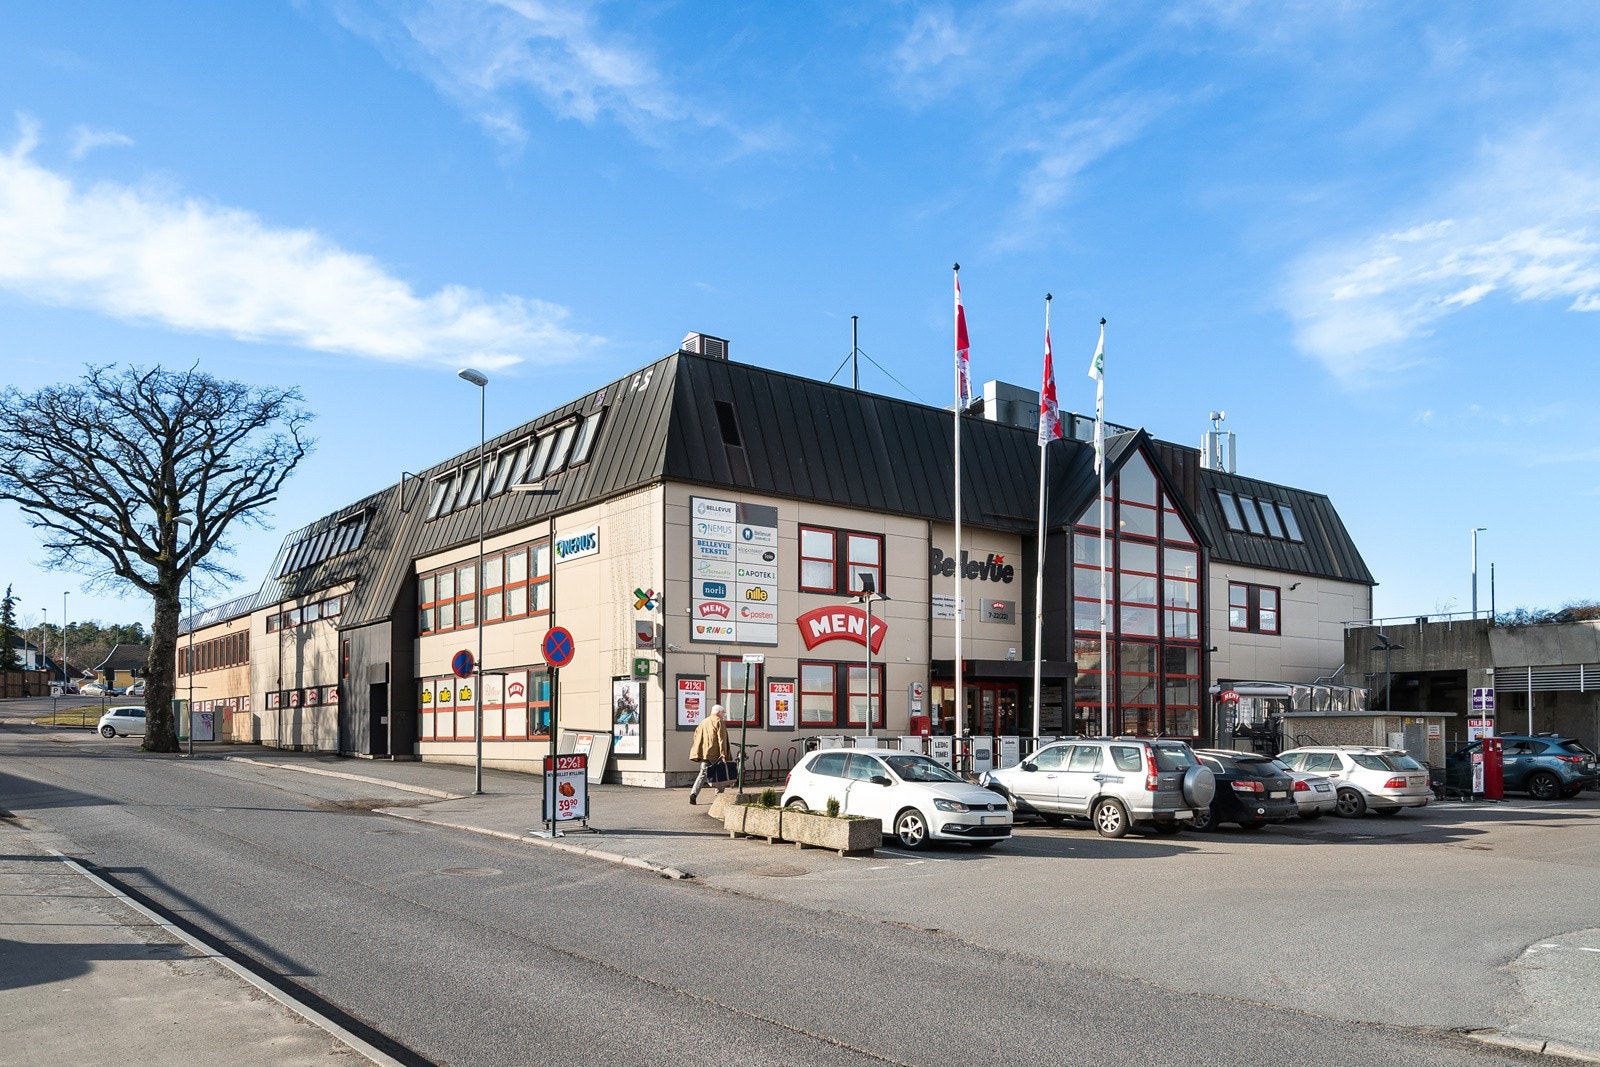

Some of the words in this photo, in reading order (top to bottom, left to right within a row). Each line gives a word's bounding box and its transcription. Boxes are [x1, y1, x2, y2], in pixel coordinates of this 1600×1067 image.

[706, 505, 731, 514] BELLEVUE
[707, 524, 732, 534] NEMUS
[563, 532, 596, 555] NEMUS
[697, 540, 732, 550] BELLEVUE
[700, 547, 729, 556] TEKSTIL
[704, 586, 724, 594] norli
[746, 587, 768, 601] nille
[702, 604, 727, 614] MENY
[750, 610, 773, 619] posten
[706, 626, 732, 634] RINGO
